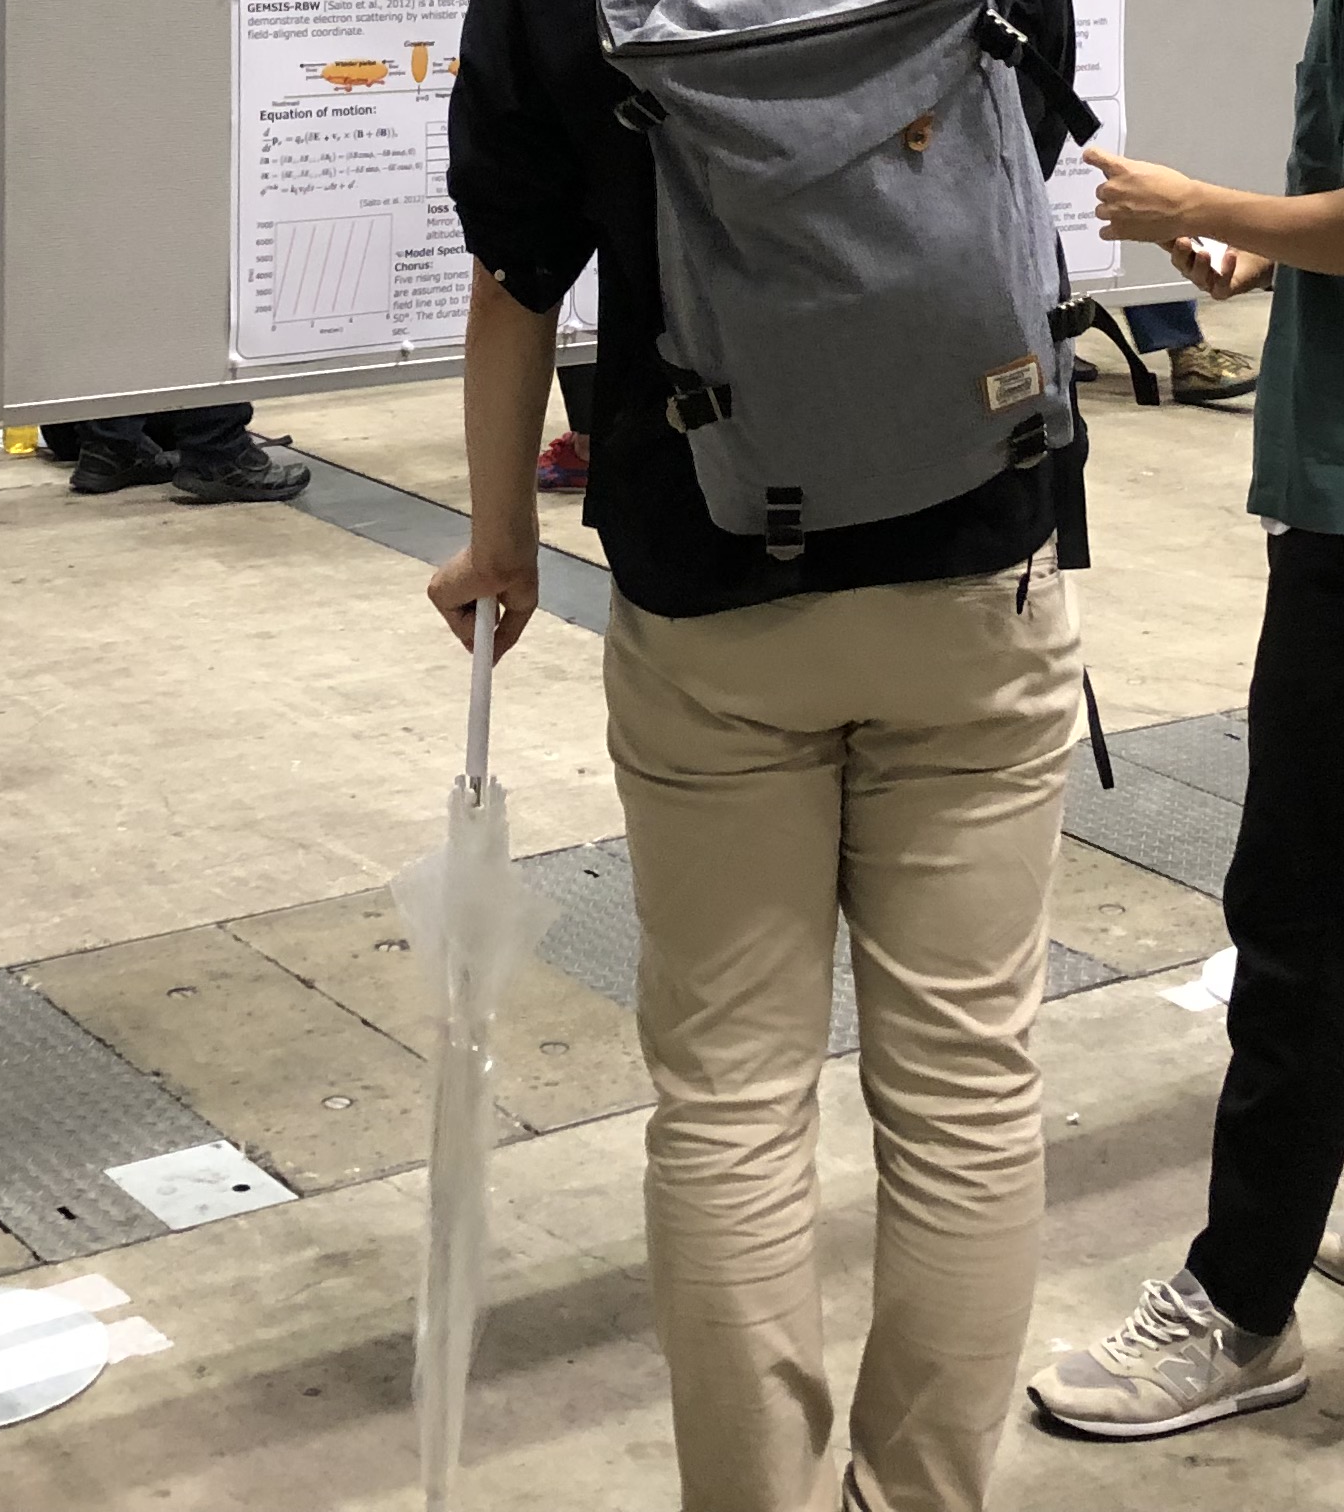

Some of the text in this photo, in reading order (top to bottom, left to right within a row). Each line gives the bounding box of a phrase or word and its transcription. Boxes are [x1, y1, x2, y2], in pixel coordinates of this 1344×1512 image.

[248, 2, 320, 13] GEMSIS-RBW
[248, 10, 457, 27] demonstrate electron scattering by whistler
[248, 28, 307, 41] field-aligned
[260, 105, 376, 123] Equation of motion:
[428, 204, 448, 214] loss
[404, 248, 434, 259] Model
[395, 261, 433, 272] Chorus:
[395, 274, 413, 284] Five
[394, 285, 452, 297] are assumed
